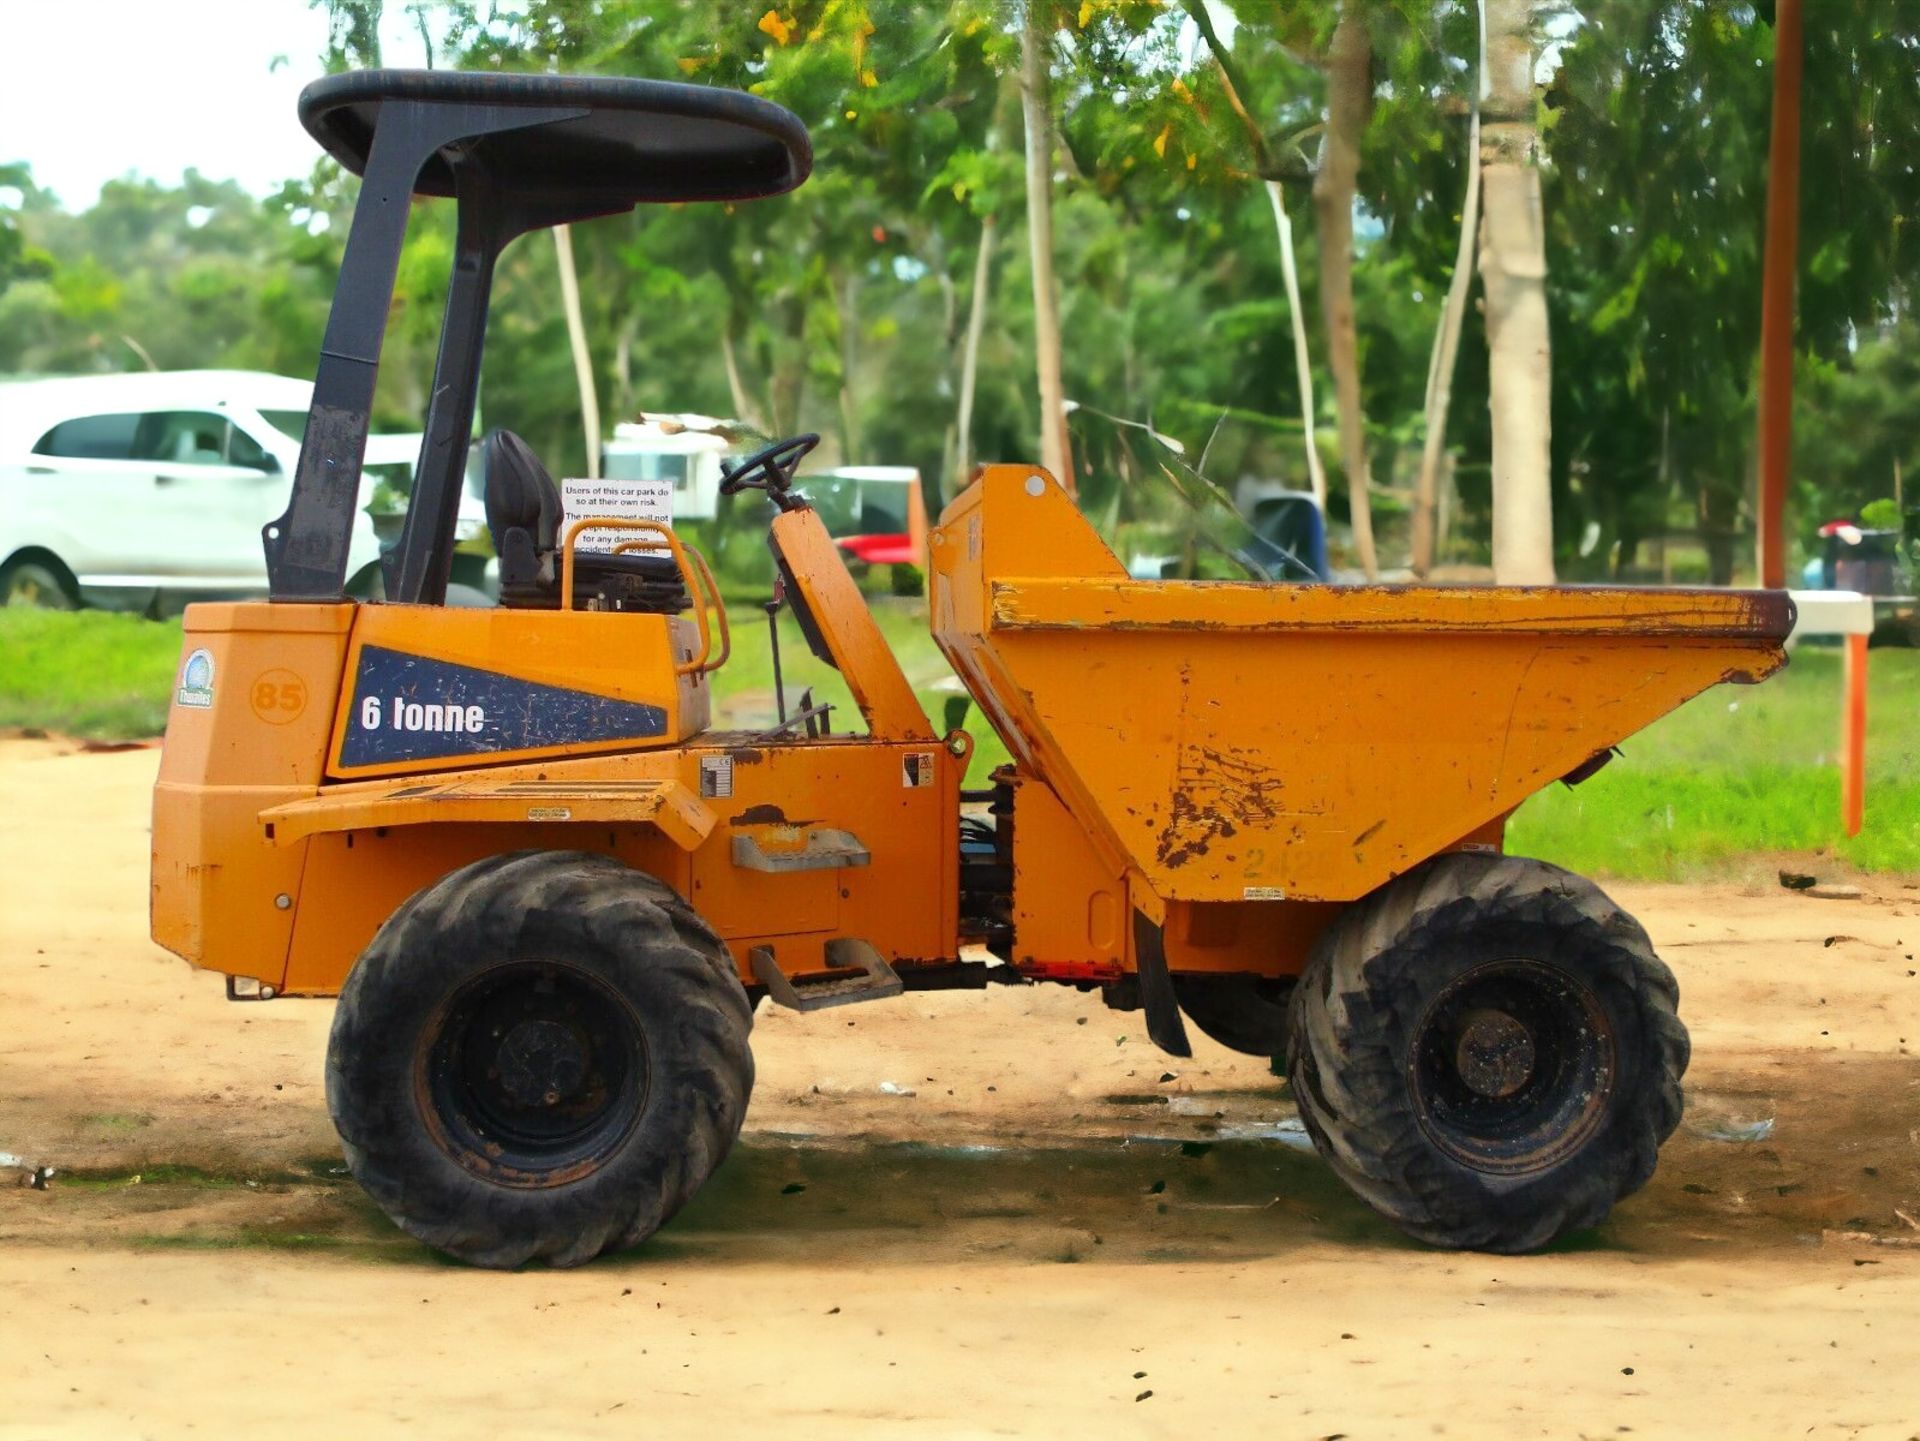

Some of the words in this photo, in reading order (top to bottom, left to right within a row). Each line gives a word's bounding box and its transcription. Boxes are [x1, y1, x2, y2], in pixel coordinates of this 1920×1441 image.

[565, 487, 590, 495] Users
[592, 487, 601, 495] of
[603, 487, 619, 495] this
[636, 488, 655, 497] park
[565, 512, 581, 520] The
[583, 535, 595, 543] for
[597, 537, 612, 545] any
[255, 682, 302, 711] 85
[361, 695, 381, 730] 6
[393, 697, 485, 733] tonne
